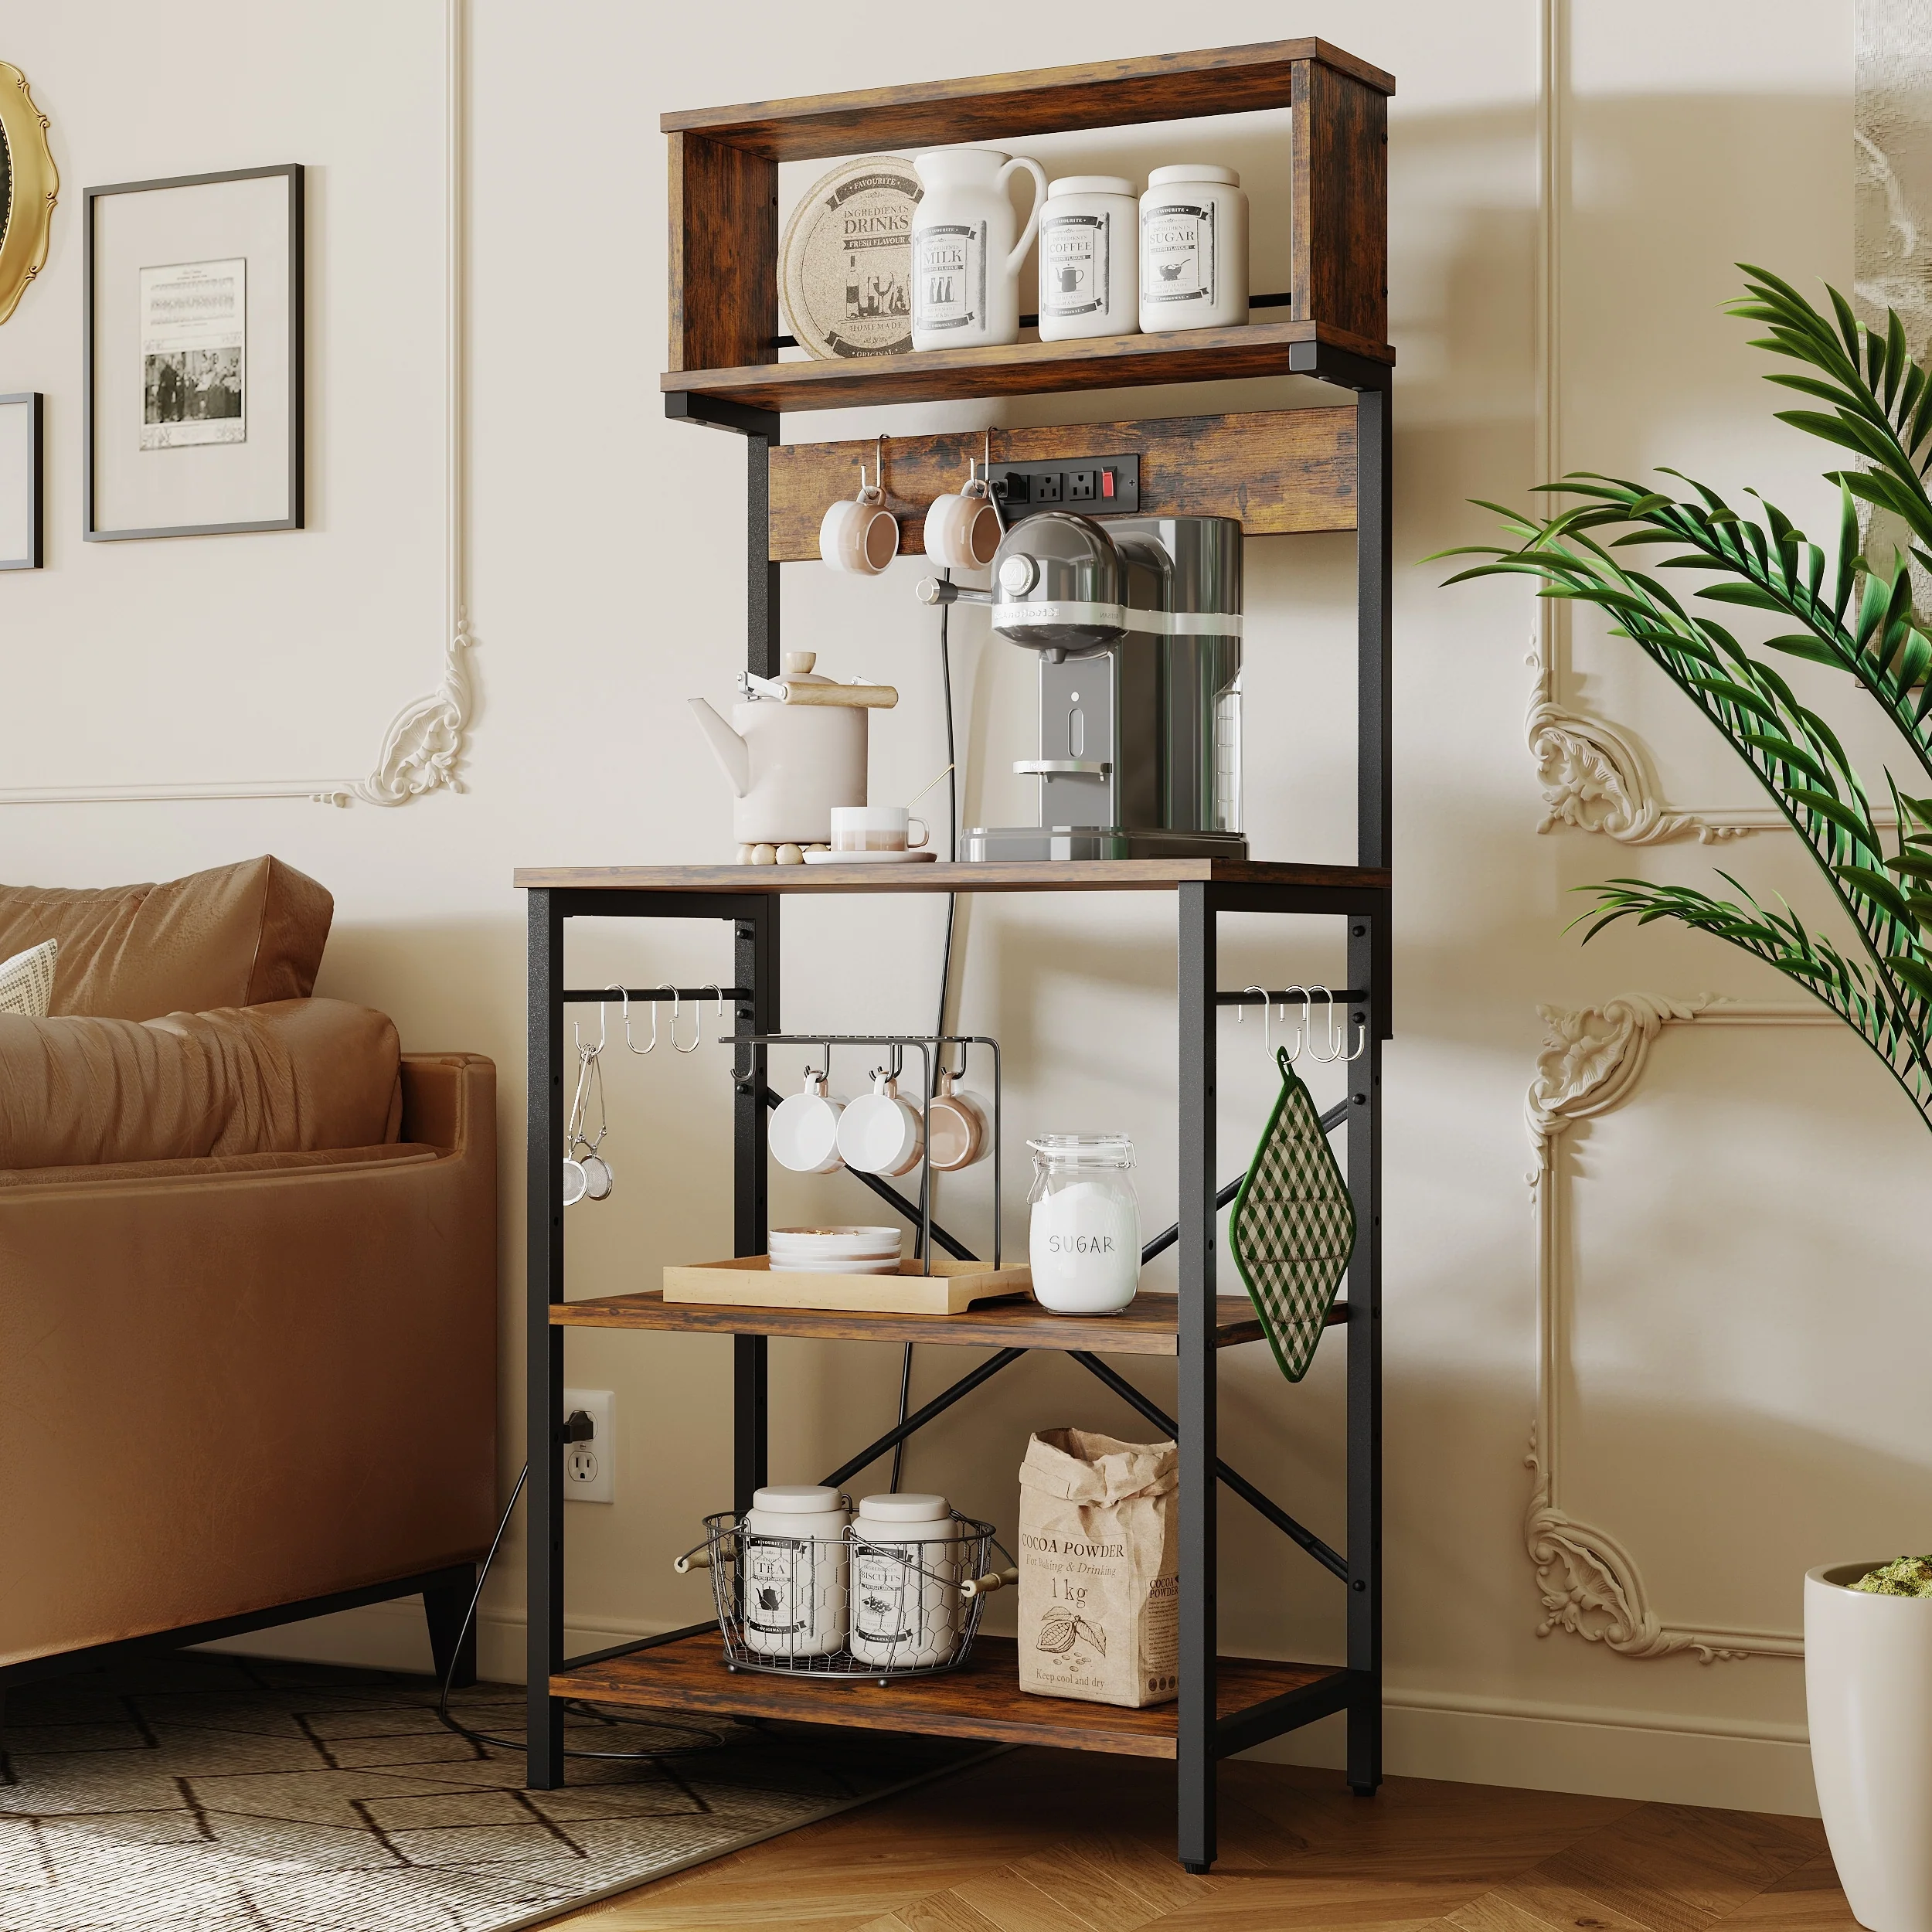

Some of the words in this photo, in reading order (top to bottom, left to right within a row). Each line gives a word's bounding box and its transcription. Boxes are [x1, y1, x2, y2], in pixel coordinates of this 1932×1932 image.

[854, 177, 896, 189] FAVOURITE
[844, 205, 909, 218] INGREDIENTS
[844, 215, 909, 234] DRINKS
[849, 239, 872, 248] FRESH
[873, 236, 906, 246] FLAVOUR
[1149, 231, 1195, 244] SUGAR
[1049, 241, 1092, 253] COFFEE
[924, 250, 962, 264] MILK
[849, 322, 902, 332] HOMEMADE
[1049, 1235, 1115, 1253] SUGAR
[1022, 1533, 1058, 1553] COCOA
[1063, 1541, 1124, 1558] POWDER
[757, 1562, 785, 1574] TEA
[1026, 1553, 1038, 1566] For
[1038, 1557, 1064, 1574] Baking
[1066, 1561, 1076, 1572] &
[1077, 1562, 1117, 1578] Drinking
[1149, 1577, 1174, 1590] COCOA
[1063, 1578, 1088, 1609] kg
[1149, 1585, 1179, 1599] POWDER
[1036, 1668, 1055, 1684] Keep
[1056, 1673, 1073, 1684] cool
[1075, 1676, 1089, 1685] and
[1091, 1677, 1105, 1691] dry
